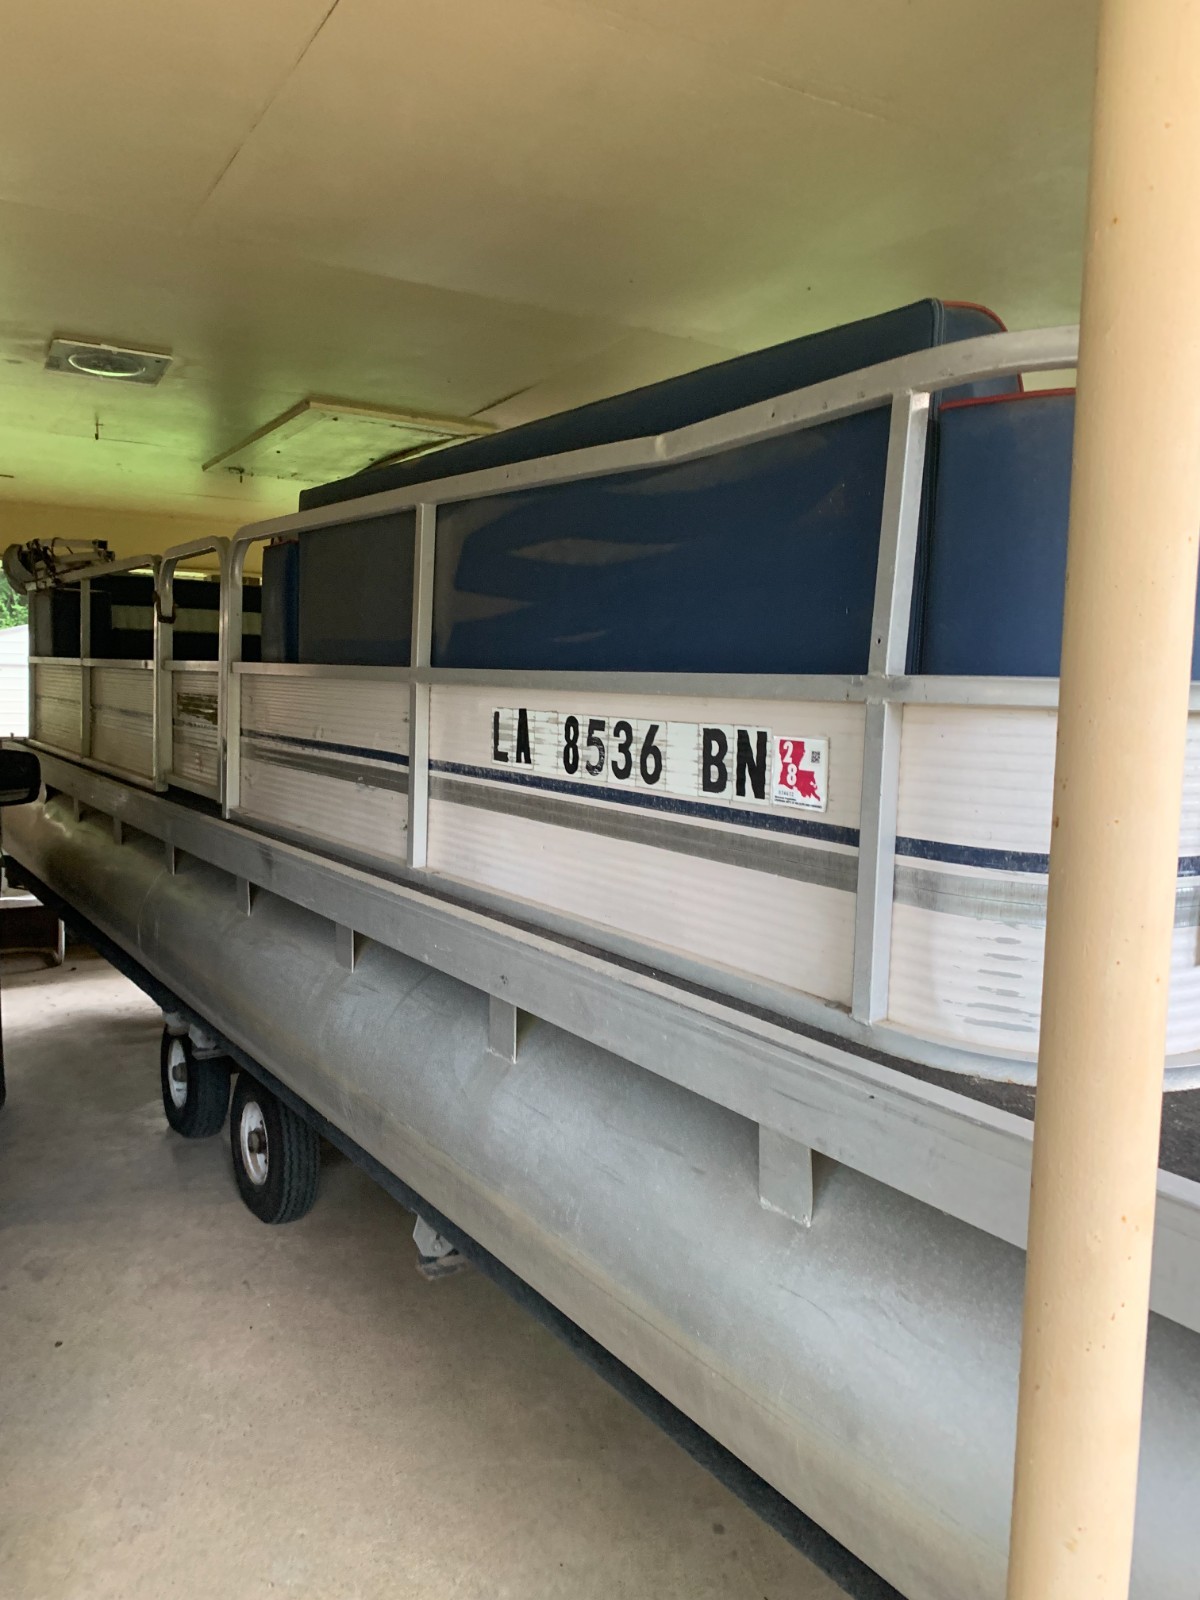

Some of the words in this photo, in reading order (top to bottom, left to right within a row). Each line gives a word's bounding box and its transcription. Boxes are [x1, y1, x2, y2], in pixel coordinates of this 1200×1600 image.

[493, 708, 532, 764] LA
[563, 715, 662, 785] 8536
[702, 727, 767, 800] BN
